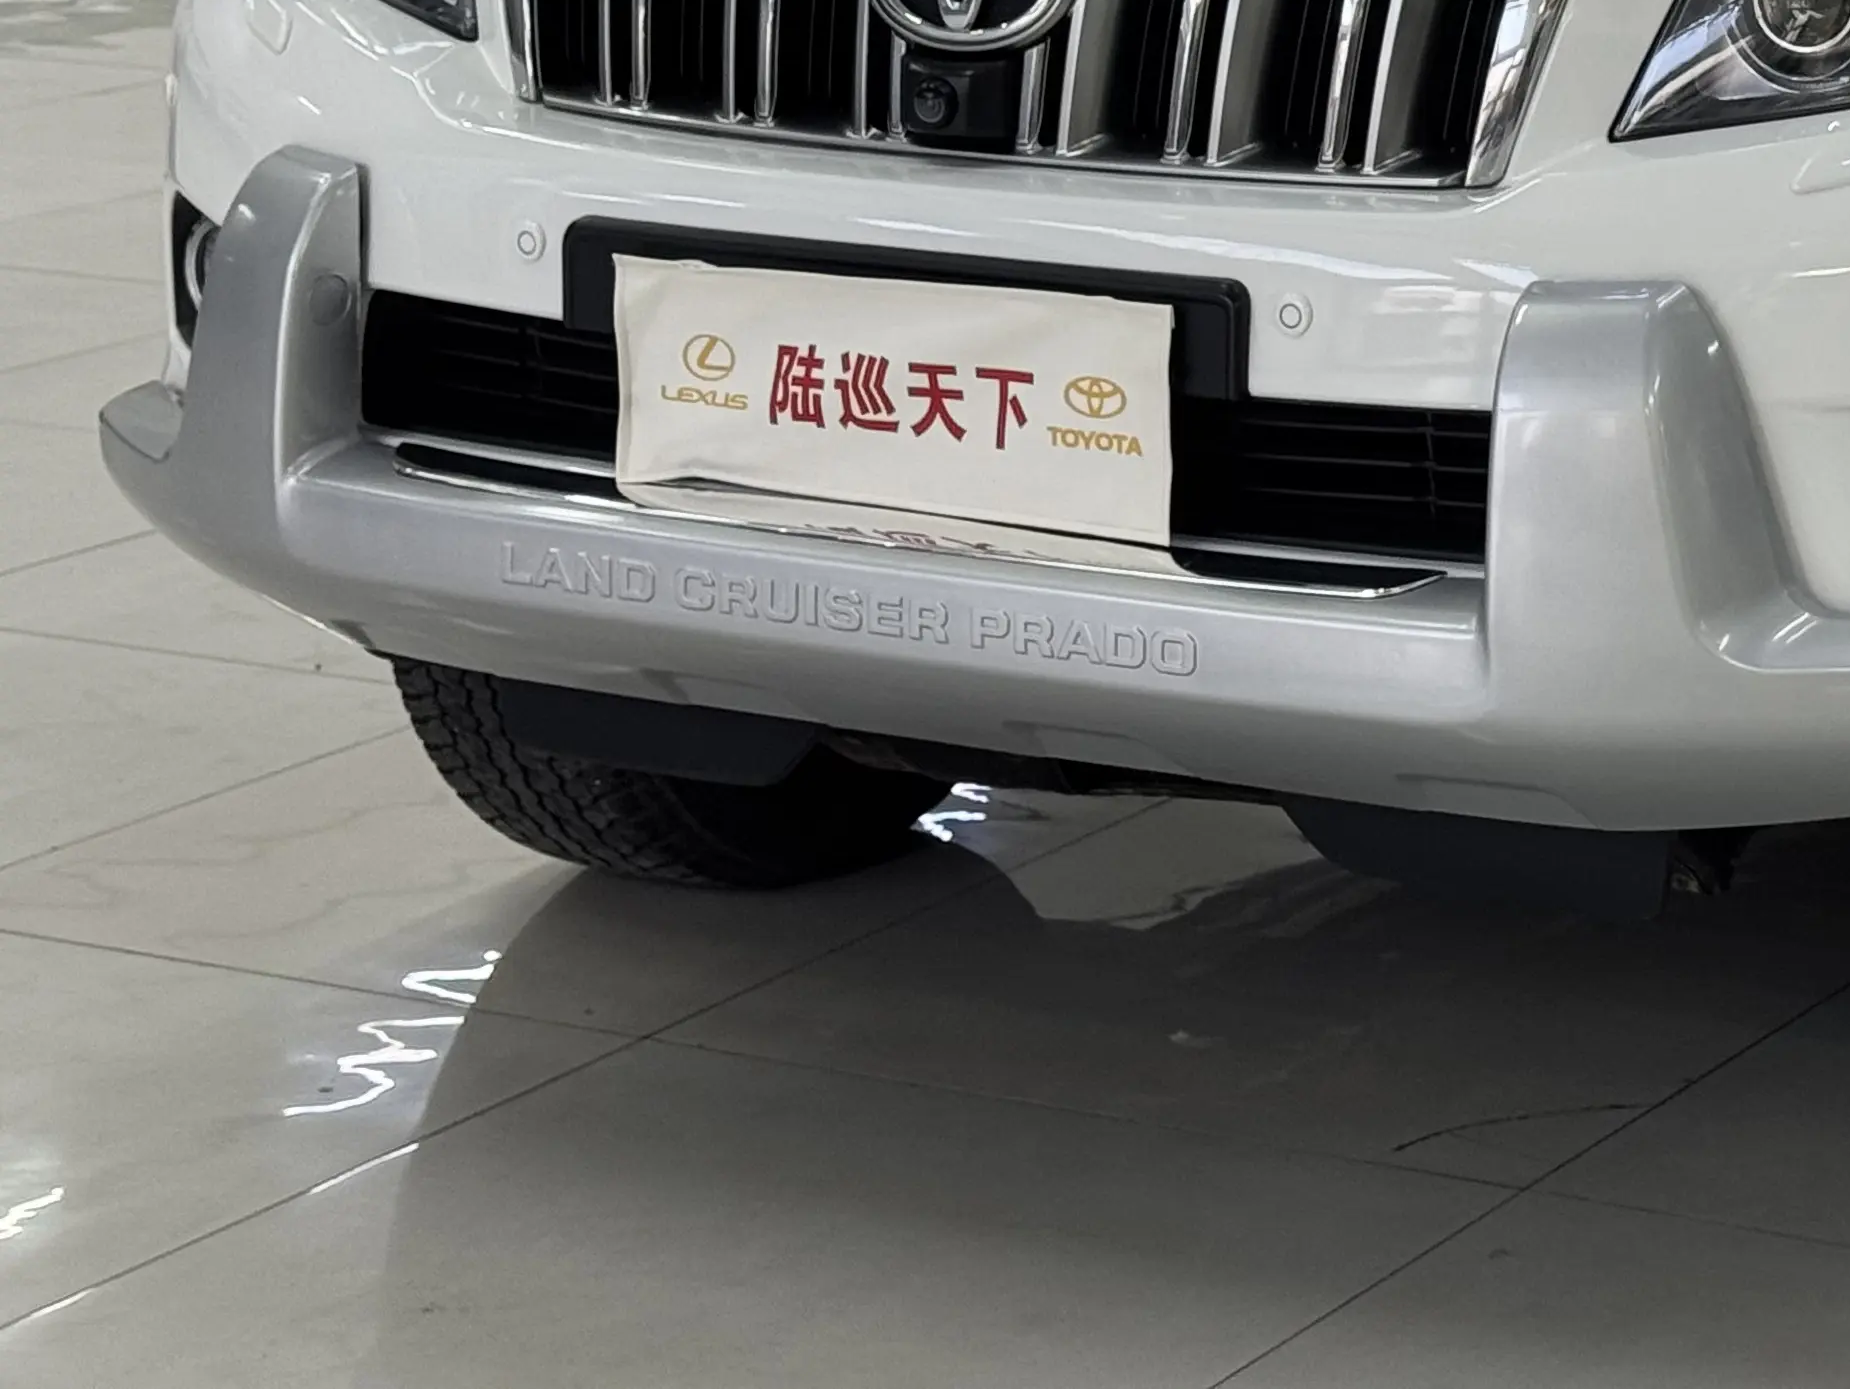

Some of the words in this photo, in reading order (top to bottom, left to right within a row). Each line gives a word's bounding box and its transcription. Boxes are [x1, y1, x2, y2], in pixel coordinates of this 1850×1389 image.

[660, 383, 749, 411] LEXUS
[768, 343, 1035, 451] 陆巡天下
[1046, 425, 1144, 458] TOYOTA
[500, 541, 656, 604] LAND
[673, 564, 951, 646] CRUISER
[969, 605, 1200, 677] PRADO
